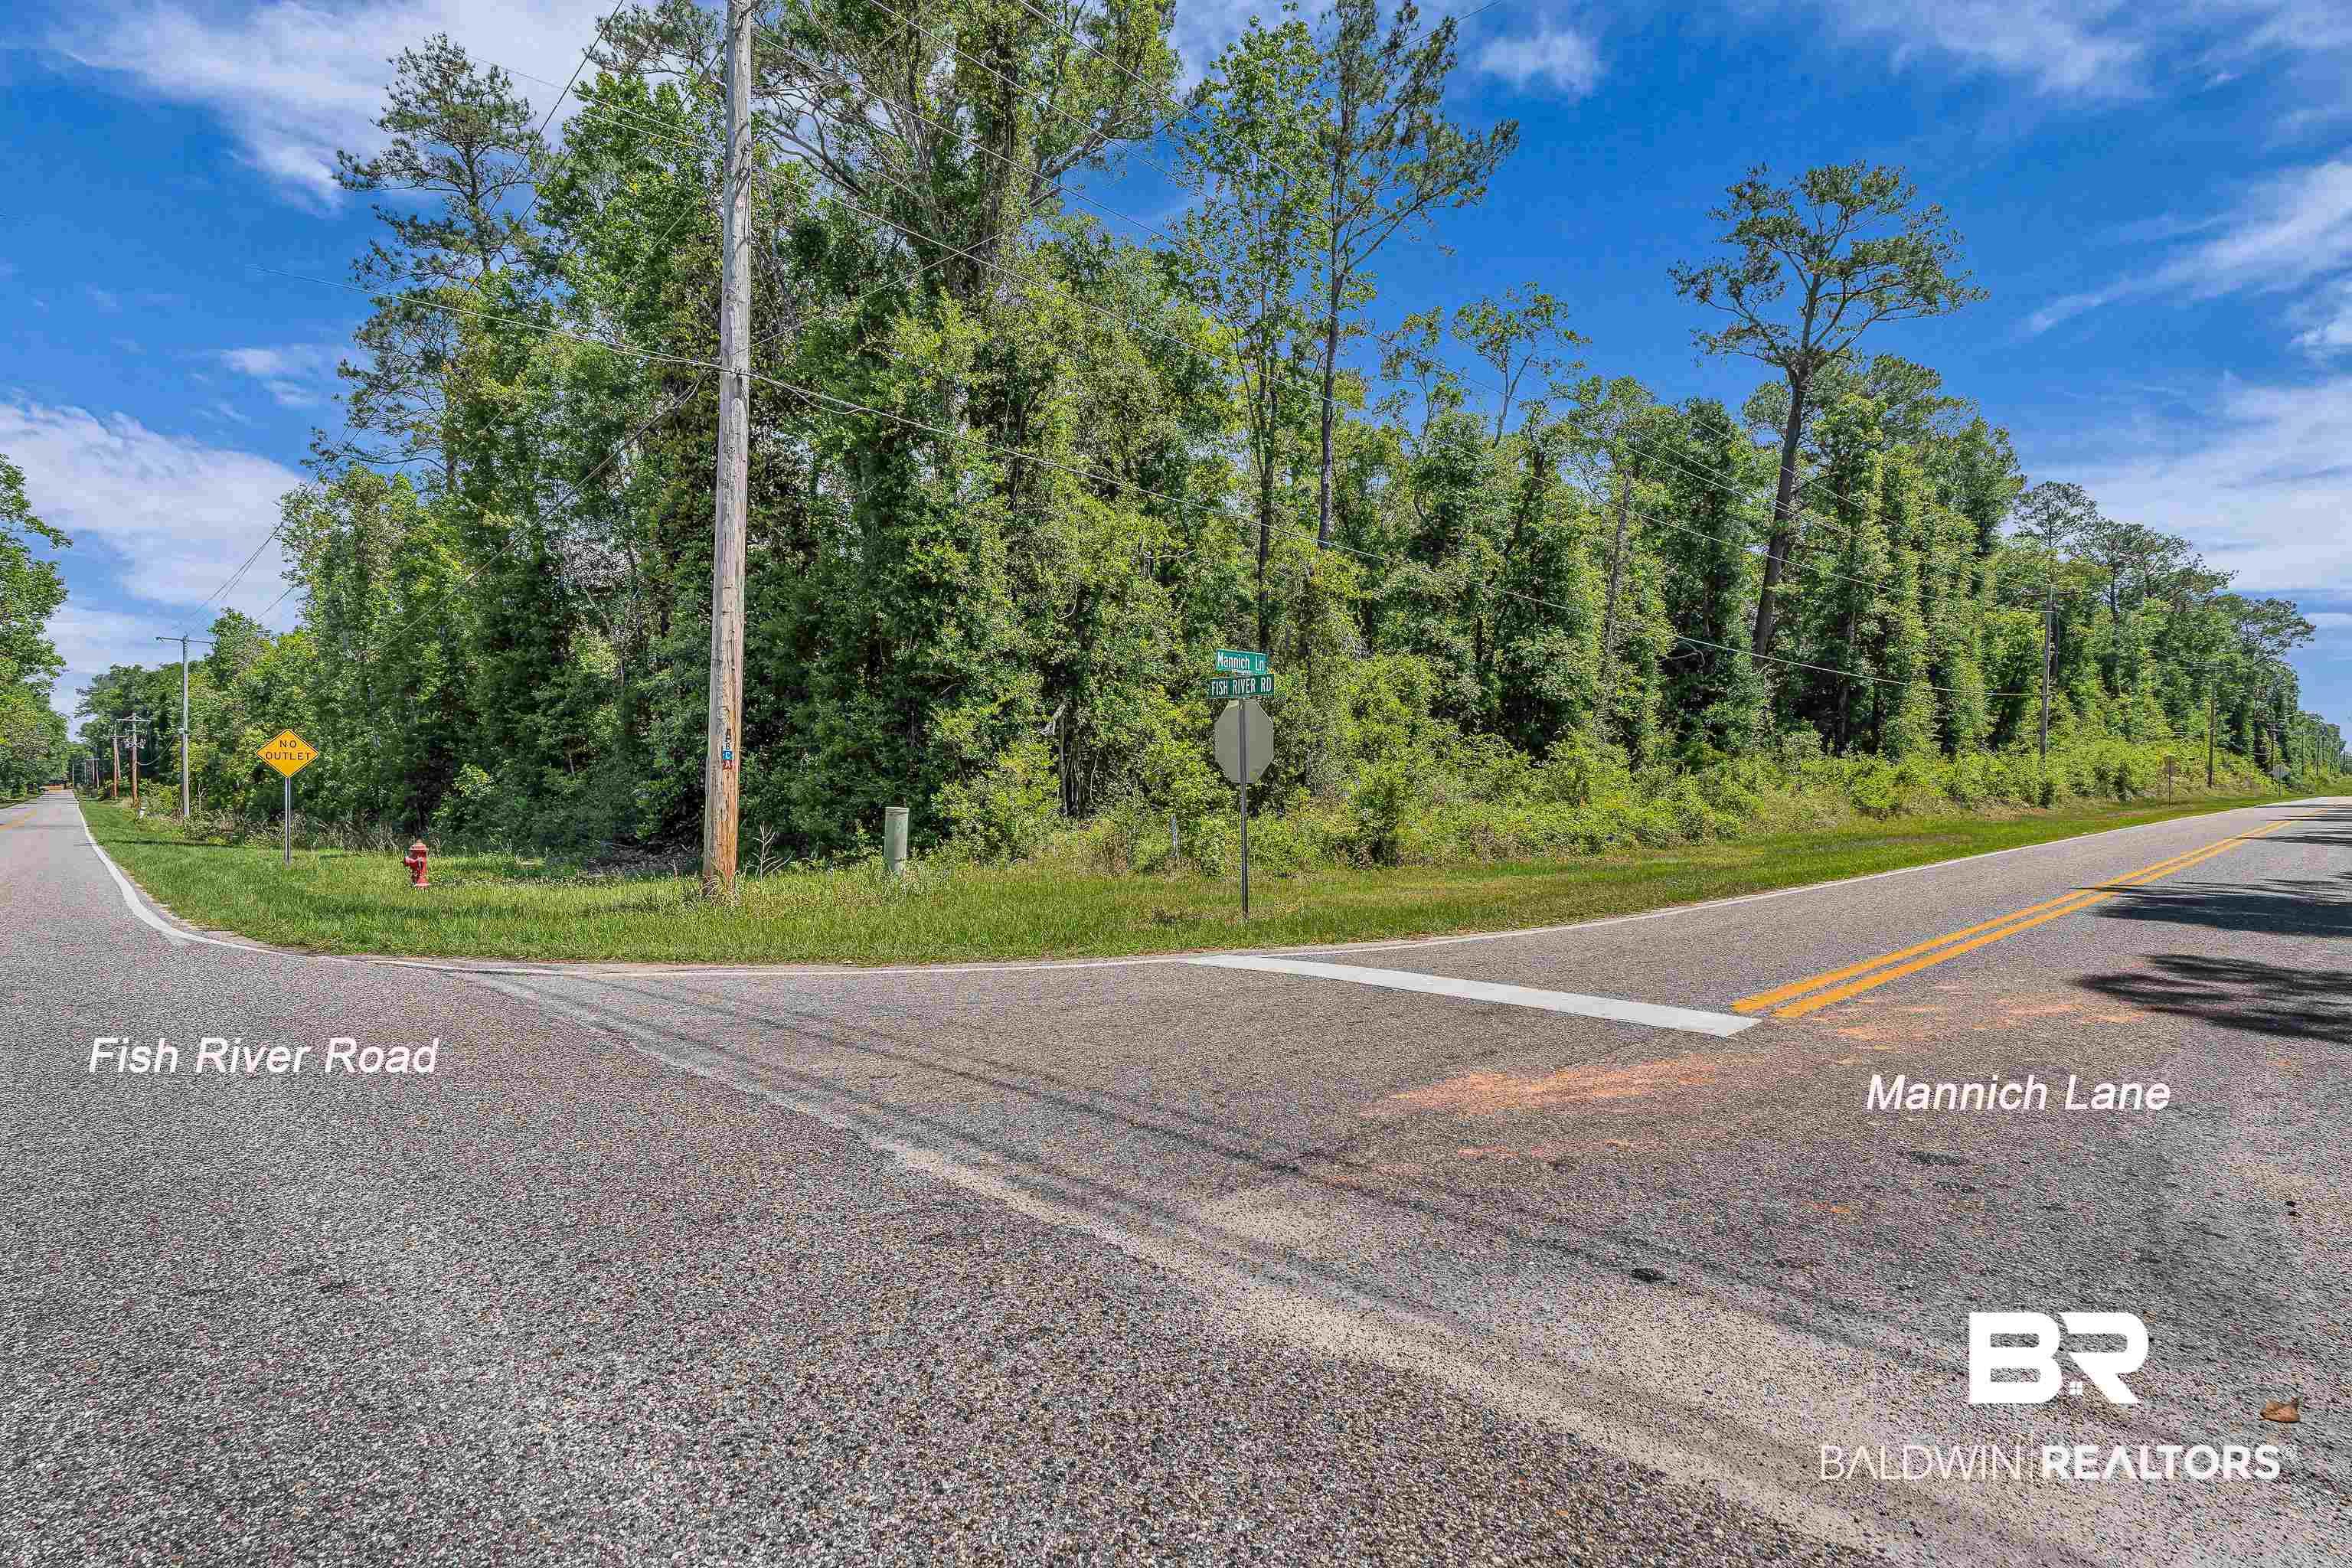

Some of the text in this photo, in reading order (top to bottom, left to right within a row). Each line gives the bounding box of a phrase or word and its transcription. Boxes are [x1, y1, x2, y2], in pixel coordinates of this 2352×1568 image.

[1217, 651, 1265, 671] Mannich Ln
[1211, 676, 1272, 696] FISH RIVER RD
[279, 740, 297, 748] NO
[265, 751, 312, 760] OUTLET
